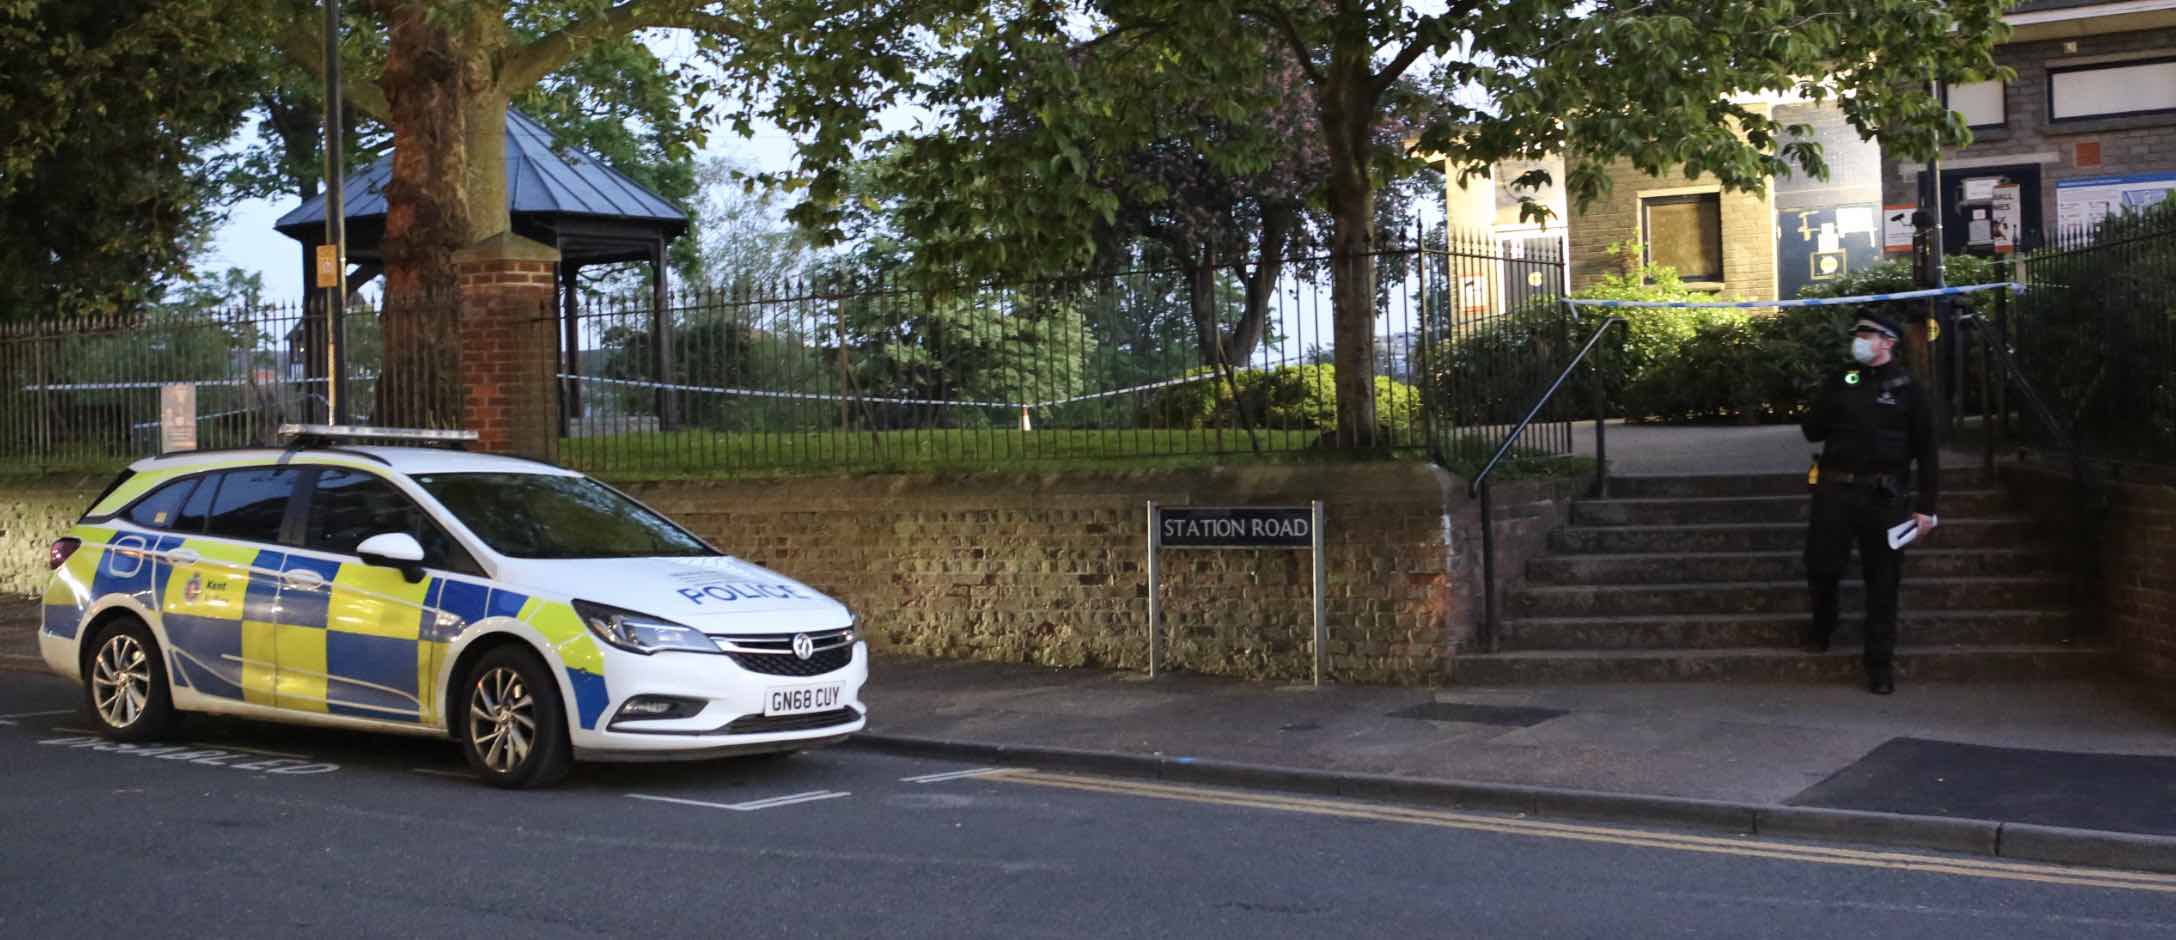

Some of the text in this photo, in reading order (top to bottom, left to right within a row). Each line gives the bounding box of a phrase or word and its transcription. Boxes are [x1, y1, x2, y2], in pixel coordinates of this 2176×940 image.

[1164, 518, 1309, 537] STATION ROAD
[676, 584, 812, 605] POLICE
[772, 686, 840, 711] GN68 CUY
